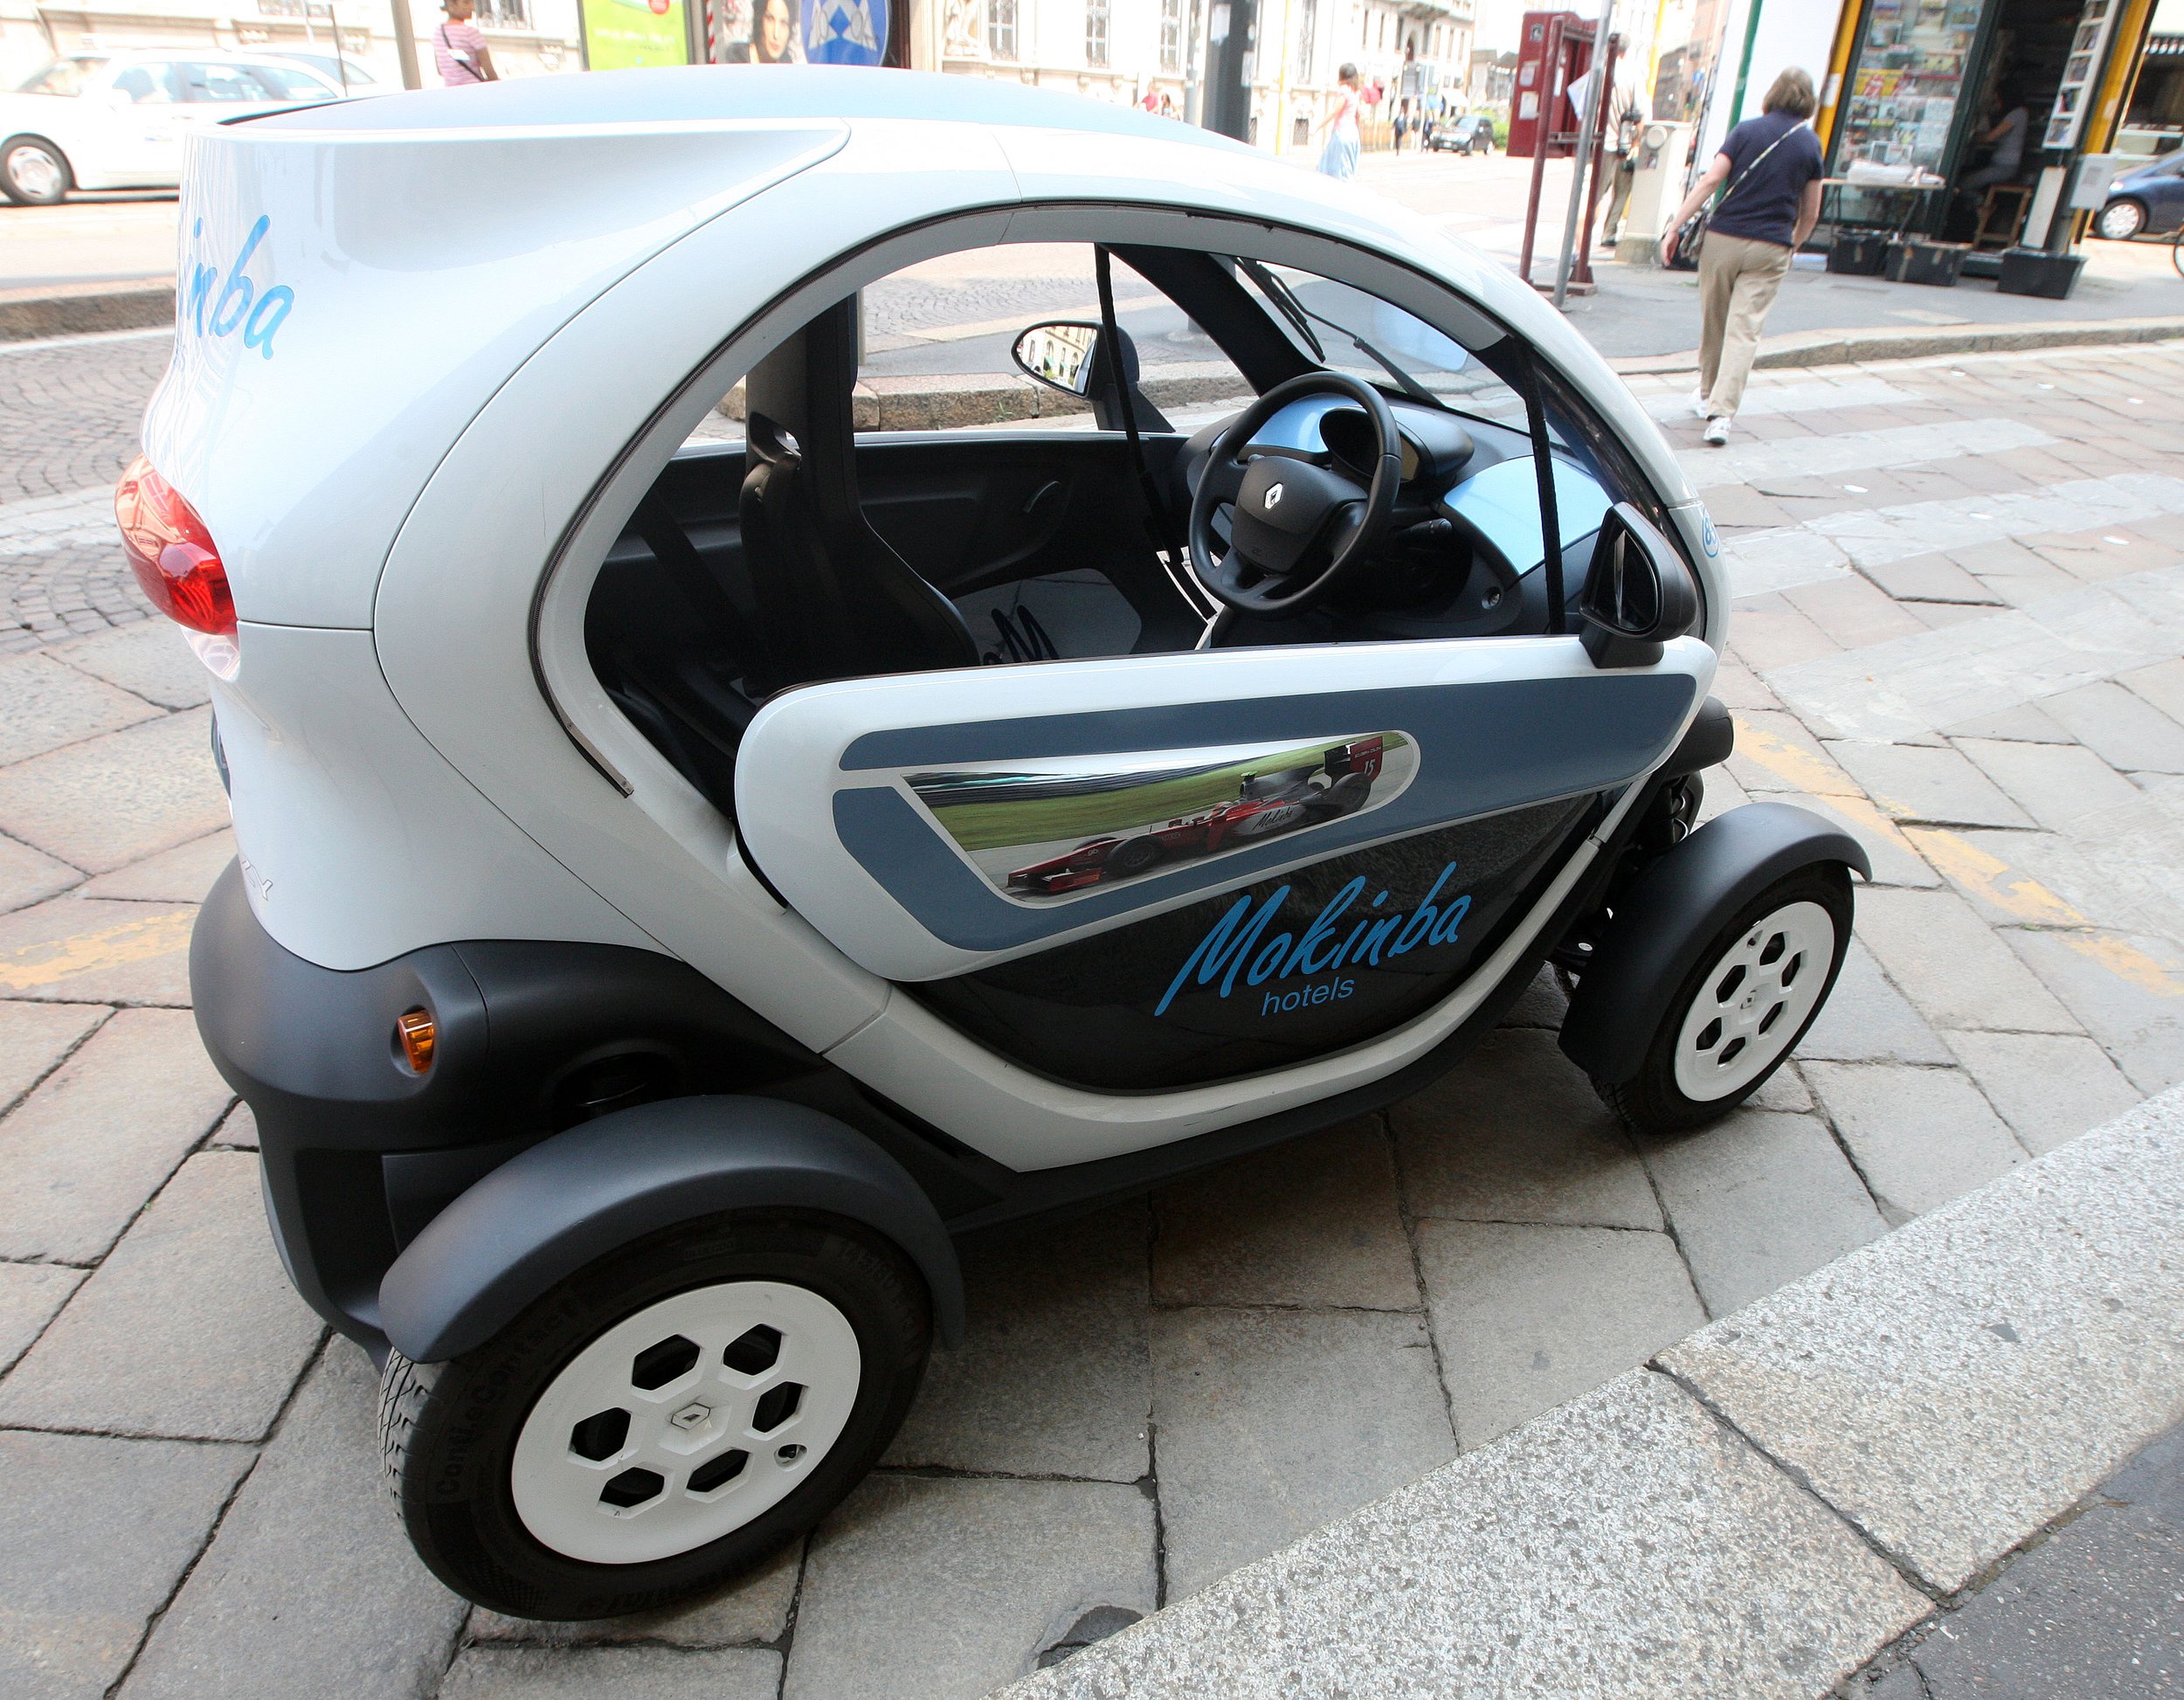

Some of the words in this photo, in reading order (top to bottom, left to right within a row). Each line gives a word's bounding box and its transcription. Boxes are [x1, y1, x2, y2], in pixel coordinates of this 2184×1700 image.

[1364, 758, 1376, 777] 15
[1154, 861, 1472, 1017] Mokinba
[1262, 976, 1354, 1016] hotels
